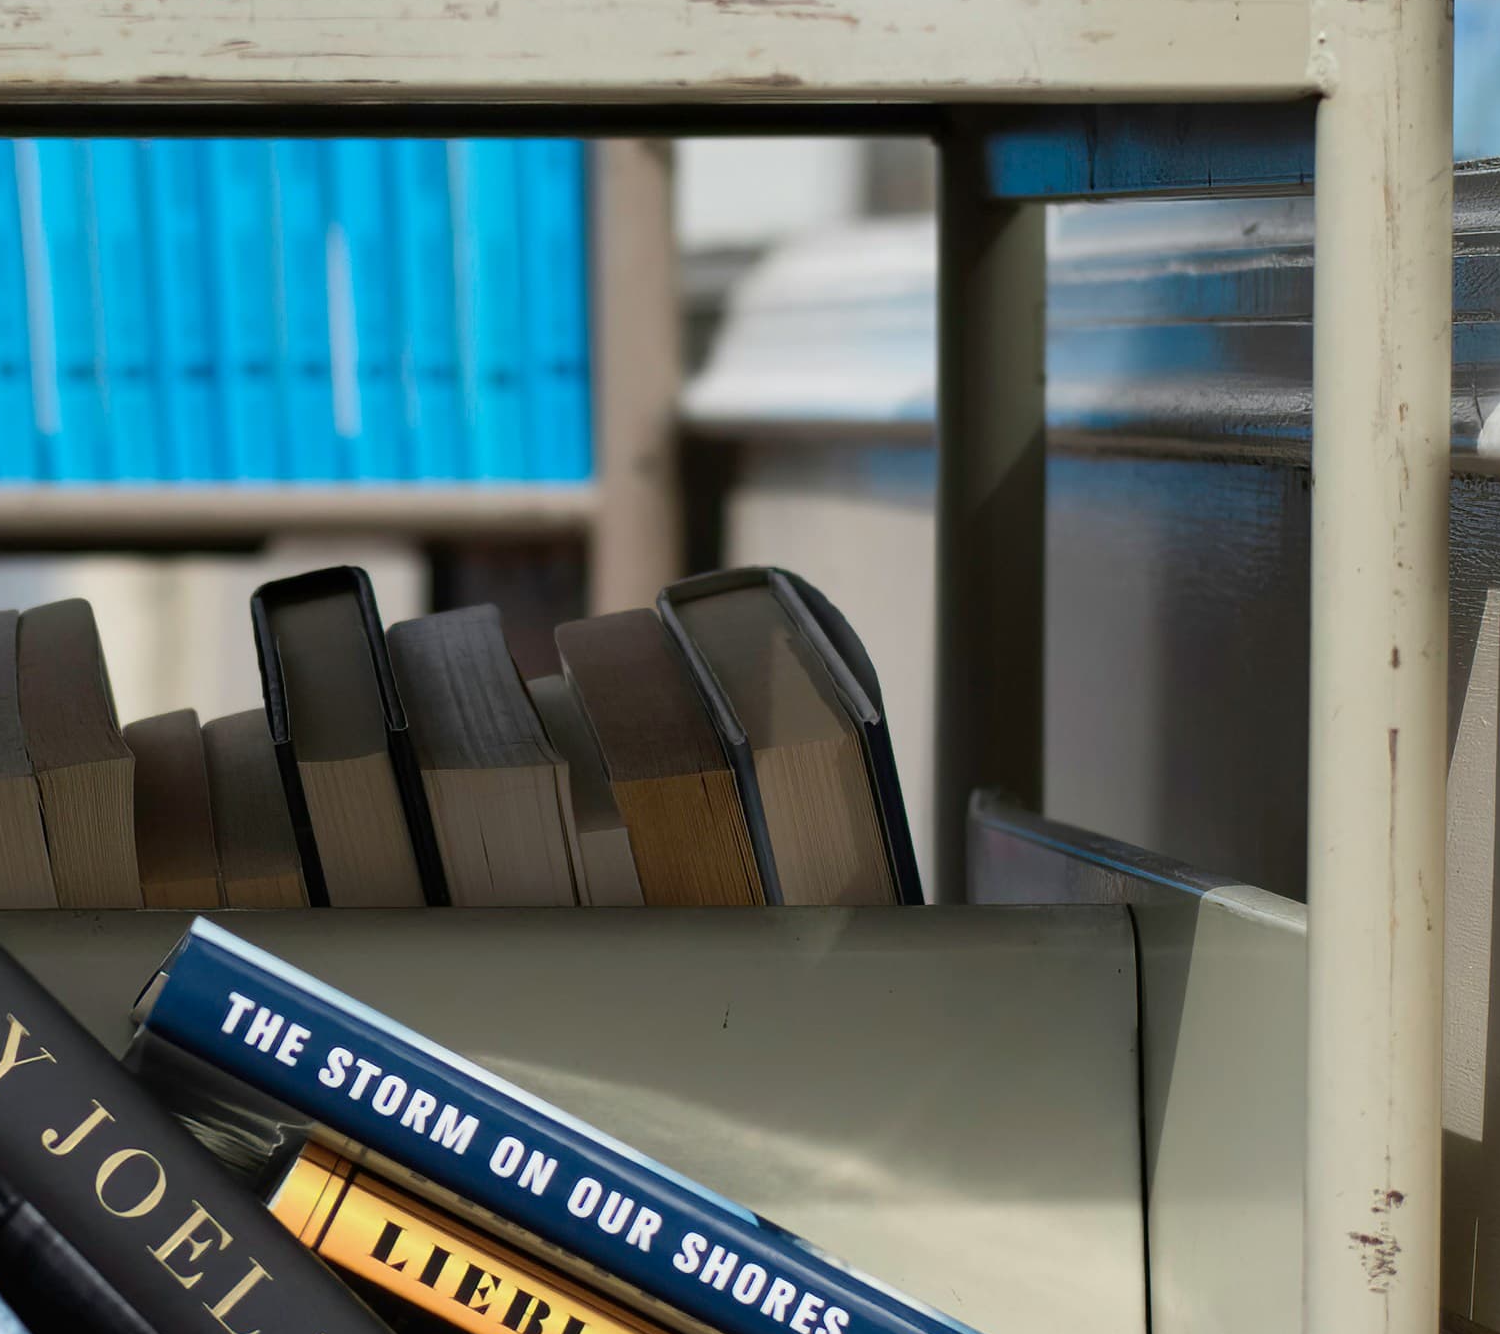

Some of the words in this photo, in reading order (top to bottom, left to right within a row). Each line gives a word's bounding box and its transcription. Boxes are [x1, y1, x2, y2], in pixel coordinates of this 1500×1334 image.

[221, 991, 312, 1067] THE
[317, 1046, 480, 1156] STORM
[488, 1135, 559, 1196] ON
[566, 1176, 663, 1253] OUR
